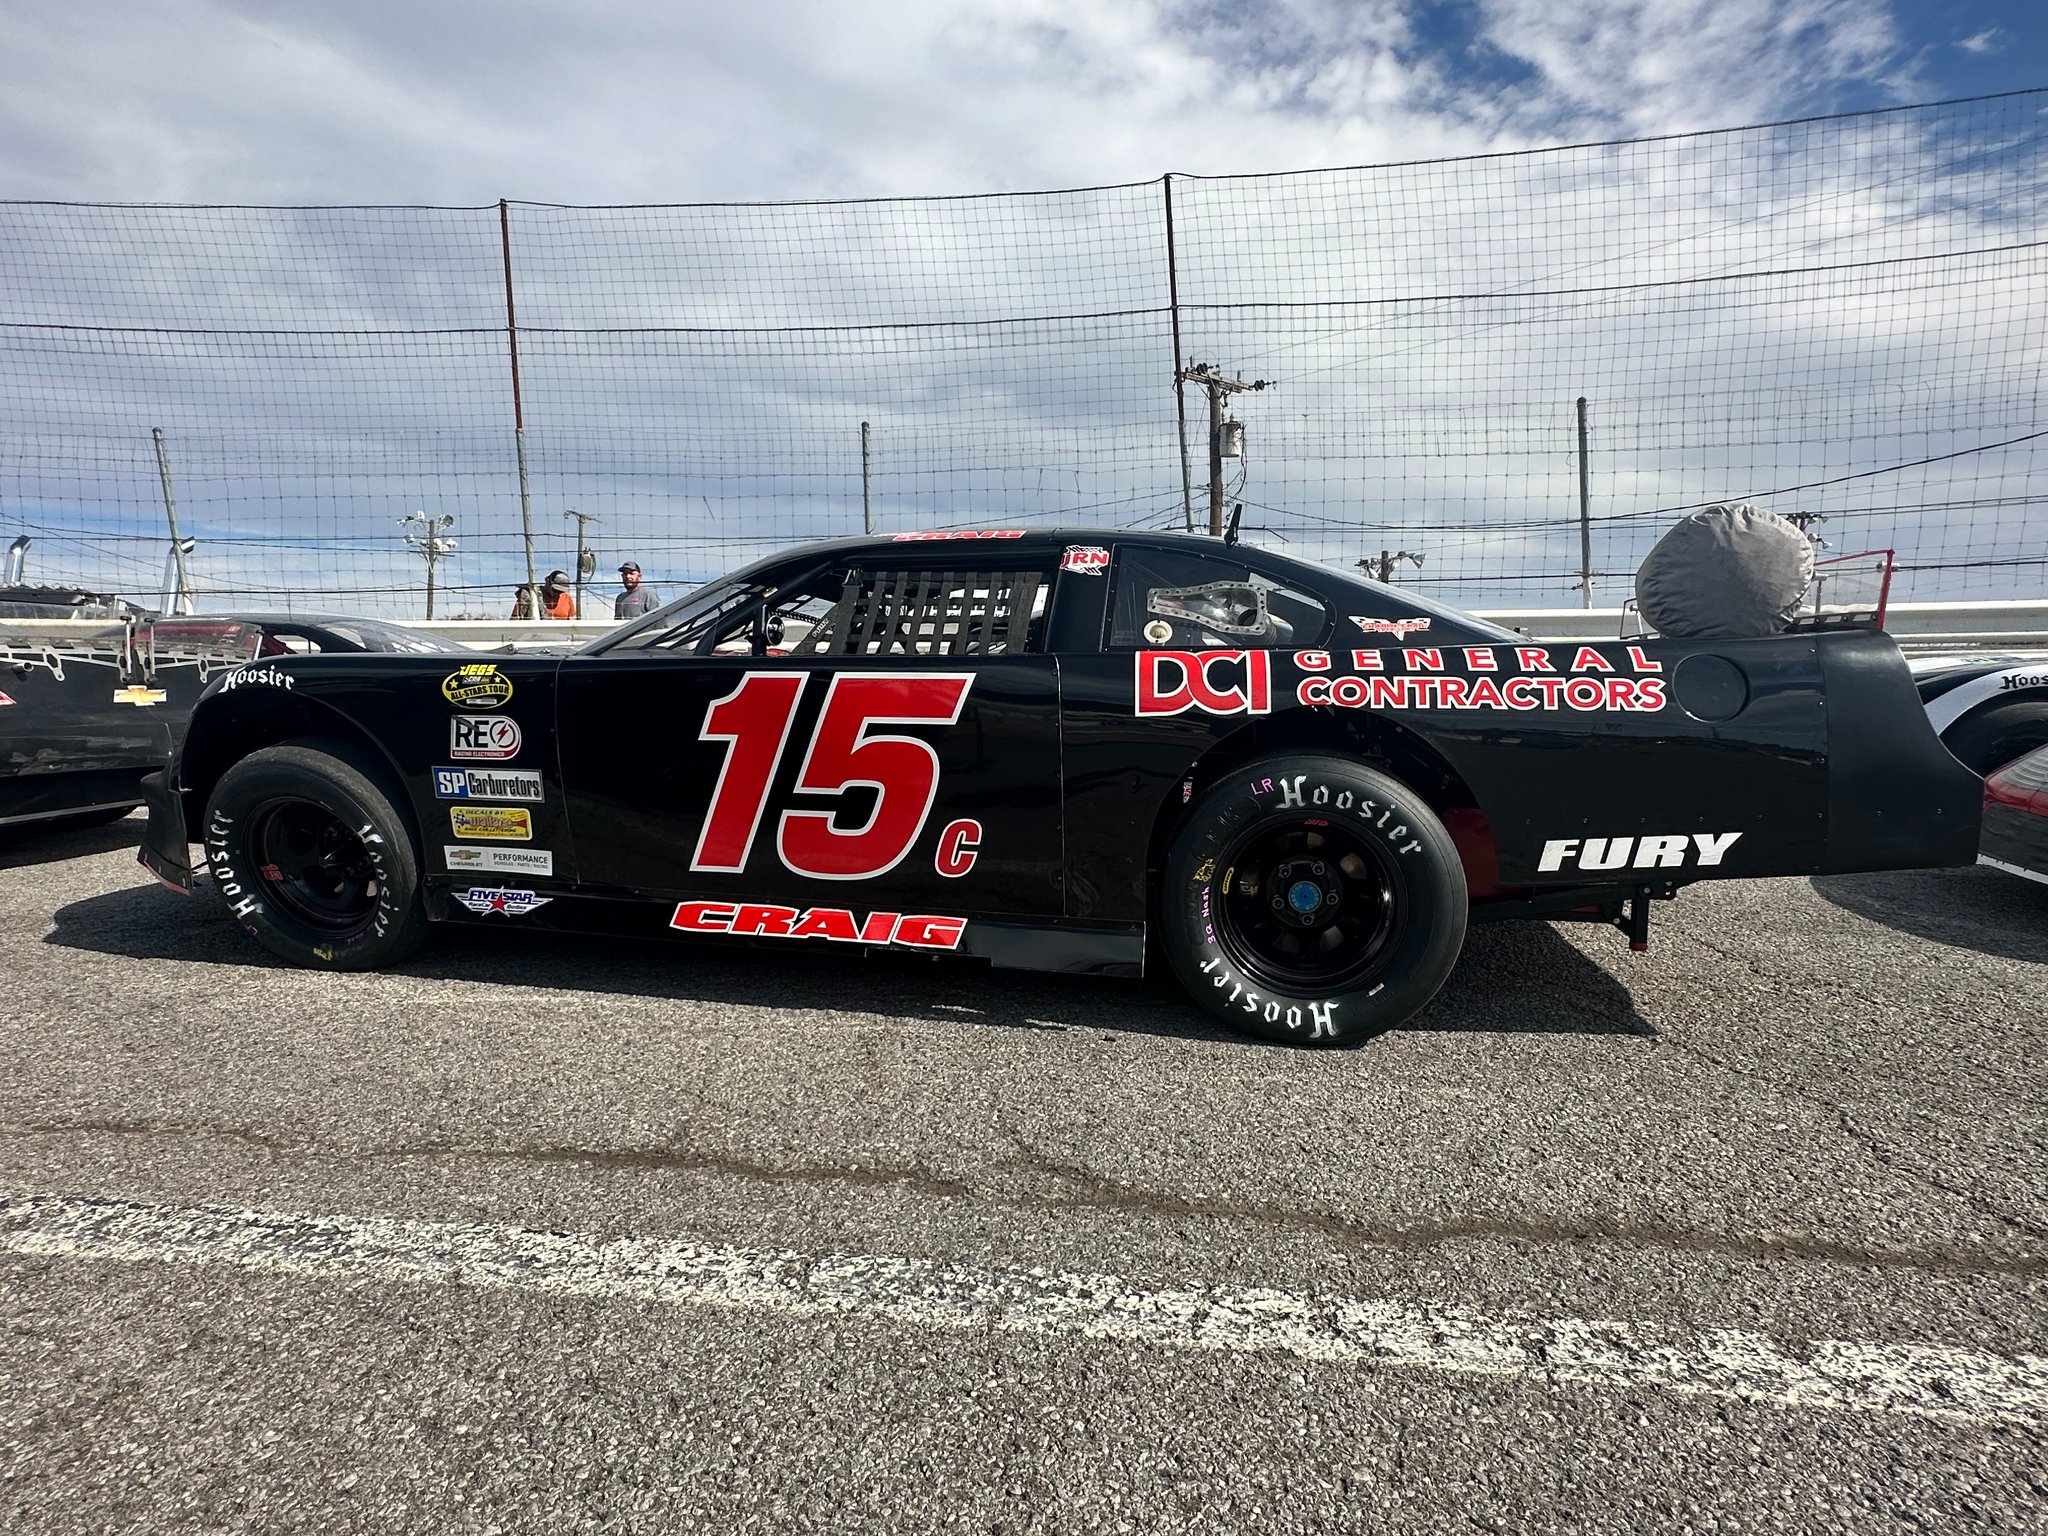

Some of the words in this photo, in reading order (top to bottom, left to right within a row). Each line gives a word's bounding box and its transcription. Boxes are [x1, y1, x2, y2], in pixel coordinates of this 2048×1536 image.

[892, 530, 1027, 541] CRAIG
[1060, 552, 1108, 568] JRN
[460, 664, 497, 675] JEGS
[1293, 645, 1663, 673] GENERAL
[218, 665, 295, 693] Hoosier
[450, 685, 487, 700] ALL-STARS
[488, 685, 509, 694] TOUR
[1135, 649, 1271, 717] DCI
[1297, 676, 1667, 712] CONTRACTORS
[438, 771, 465, 794] SP
[468, 772, 541, 798] Carburetors
[689, 671, 976, 880] 15
[1250, 778, 1275, 795] LR
[1275, 775, 1422, 854] Hoosier
[206, 809, 264, 920] Hoosier
[493, 853, 548, 864] PERFORMANCE
[1537, 831, 1744, 872] FURY
[469, 890, 499, 900] FIVE
[502, 892, 534, 903] STAR
[669, 901, 968, 949] CRAIG
[1199, 957, 1340, 1039] Hoosier
